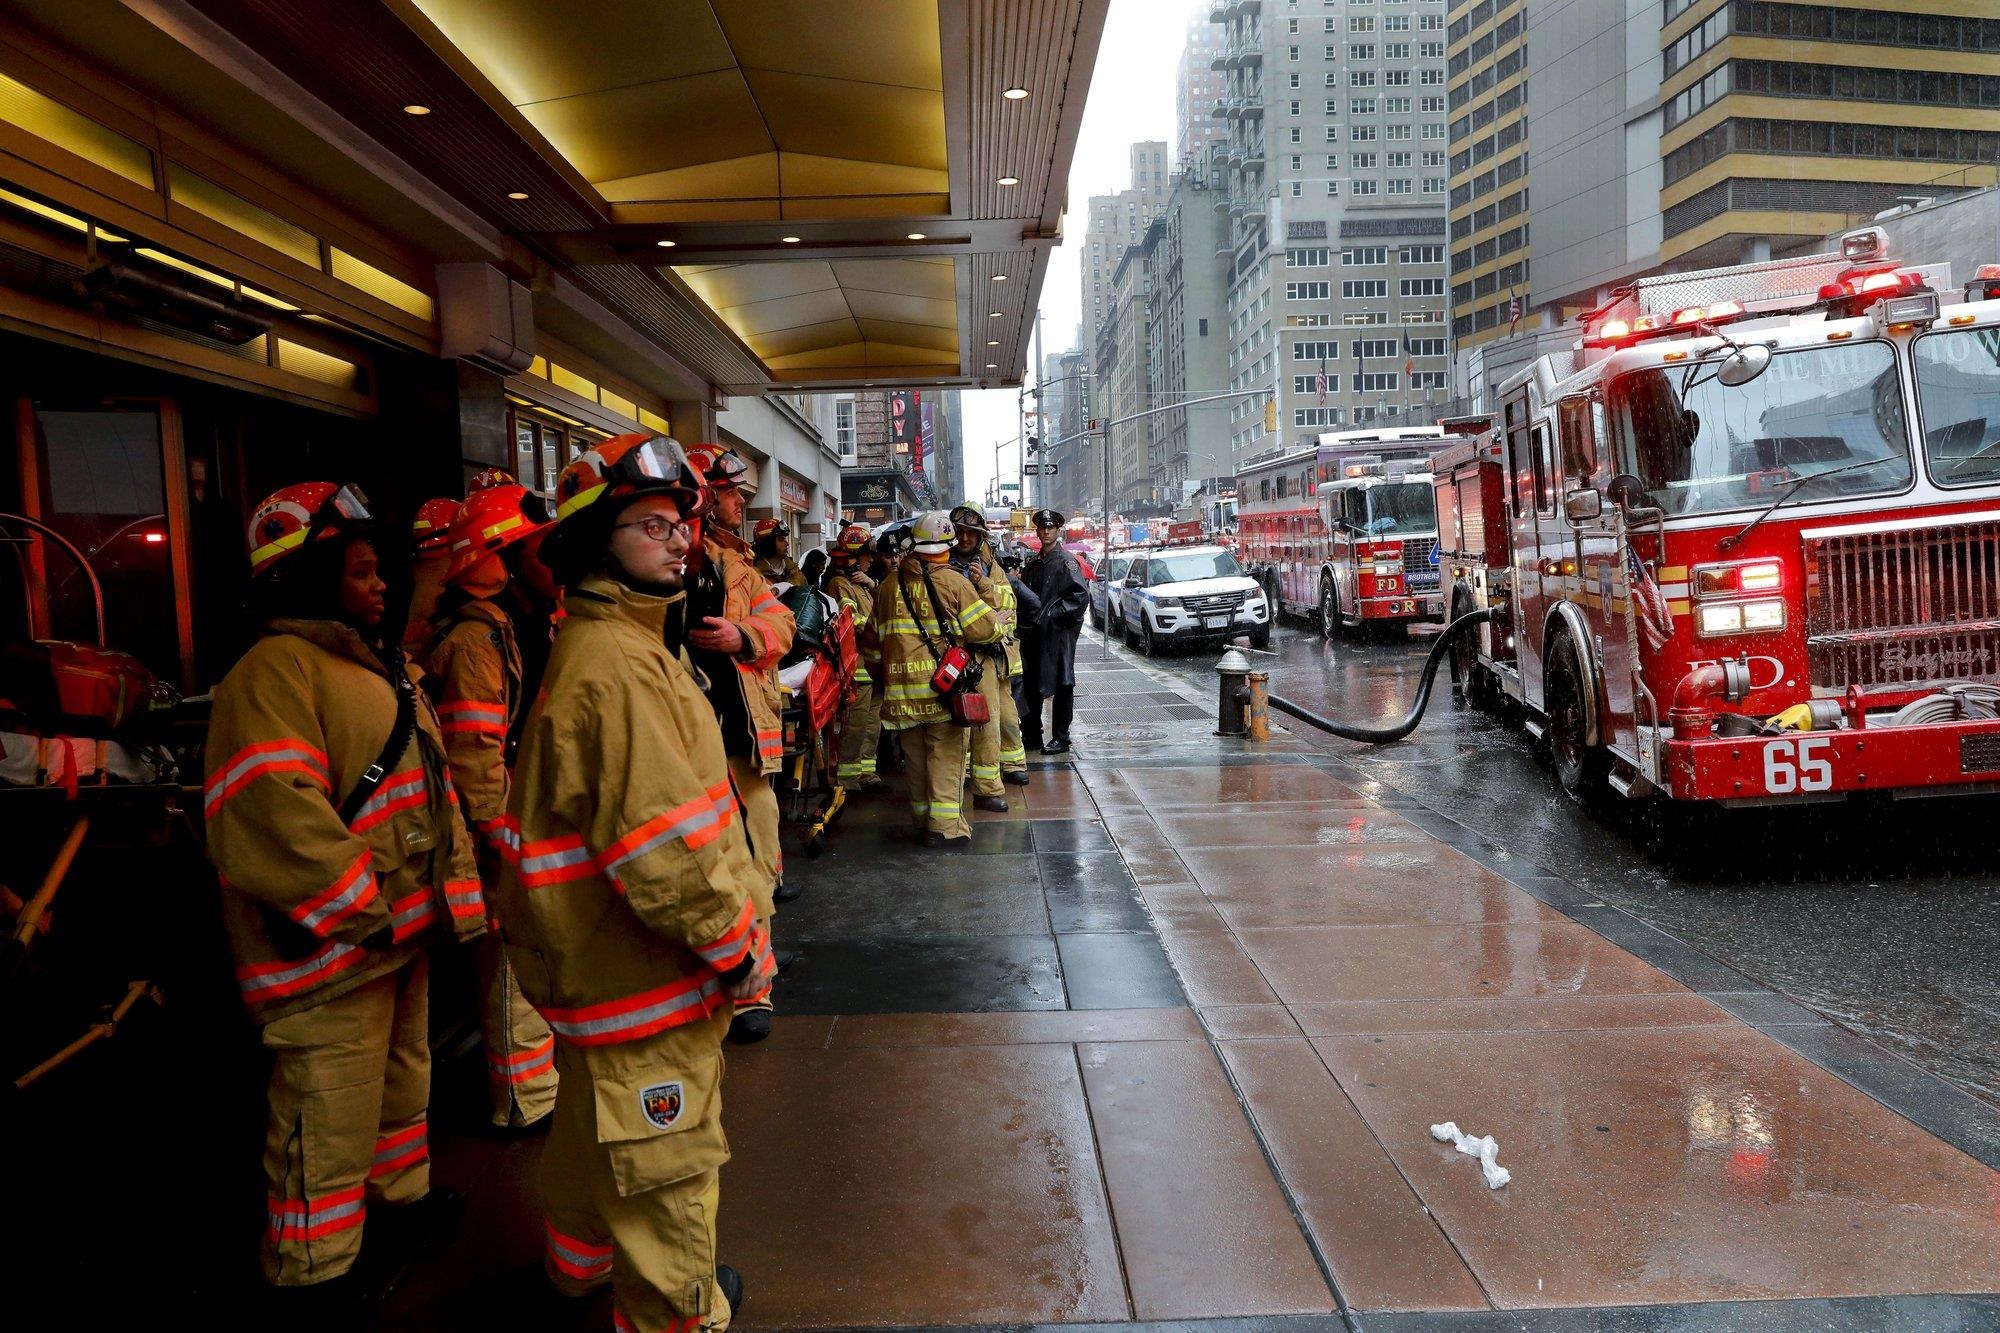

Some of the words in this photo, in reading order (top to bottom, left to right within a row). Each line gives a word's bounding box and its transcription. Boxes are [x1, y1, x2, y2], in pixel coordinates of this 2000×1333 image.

[257, 503, 280, 519] EMT
[1407, 572, 1440, 581] BROTHERS
[896, 600, 929, 617] ES
[1403, 600, 1416, 613] R
[888, 659, 938, 674] IEUTENANT
[1763, 738, 1833, 794] 65
